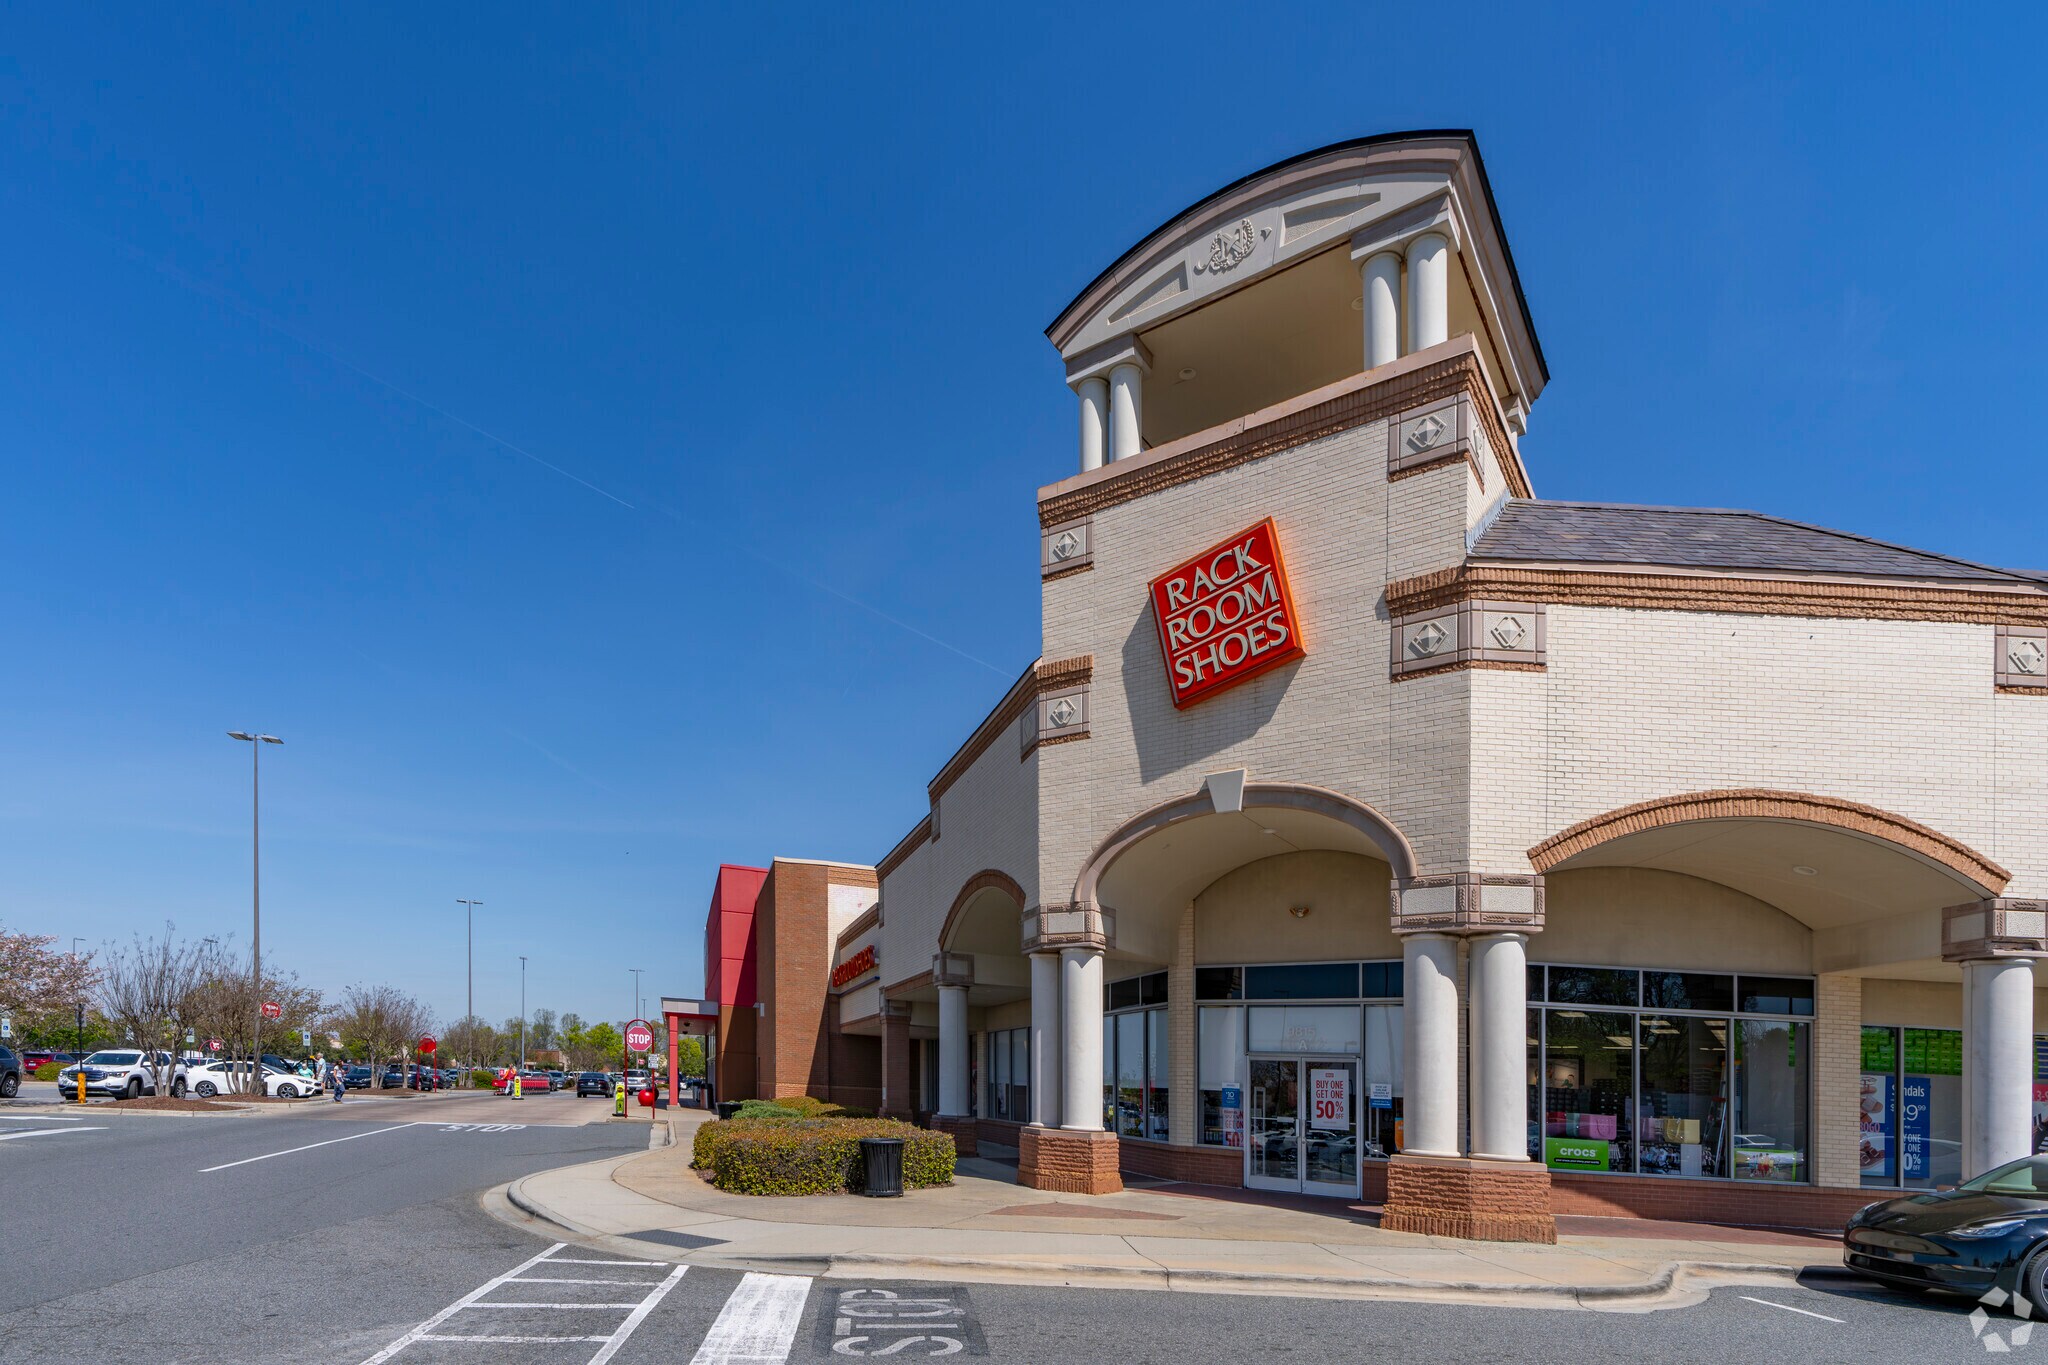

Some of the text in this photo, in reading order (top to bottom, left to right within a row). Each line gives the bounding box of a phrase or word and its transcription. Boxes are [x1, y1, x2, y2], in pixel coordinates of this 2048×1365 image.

[1165, 537, 1262, 612] RACK
[1166, 571, 1281, 651] ROOM
[1174, 611, 1289, 689] SHOES
[628, 1033, 650, 1044] STOP
[1298, 1040, 1307, 1049] A
[1316, 1080, 1343, 1089] BUY ONE
[1316, 1090, 1343, 1099] GET ONE
[1892, 1084, 1925, 1097] Sndals
[1316, 1101, 1343, 1119] 50%
[438, 1124, 527, 1132] STOP
[1908, 1134, 1921, 1142] ONE
[1560, 1148, 1596, 1157] crocs
[1908, 1144, 1921, 1152] ONE
[1904, 1153, 1921, 1170] 0%
[832, 1289, 966, 1356] STOP
